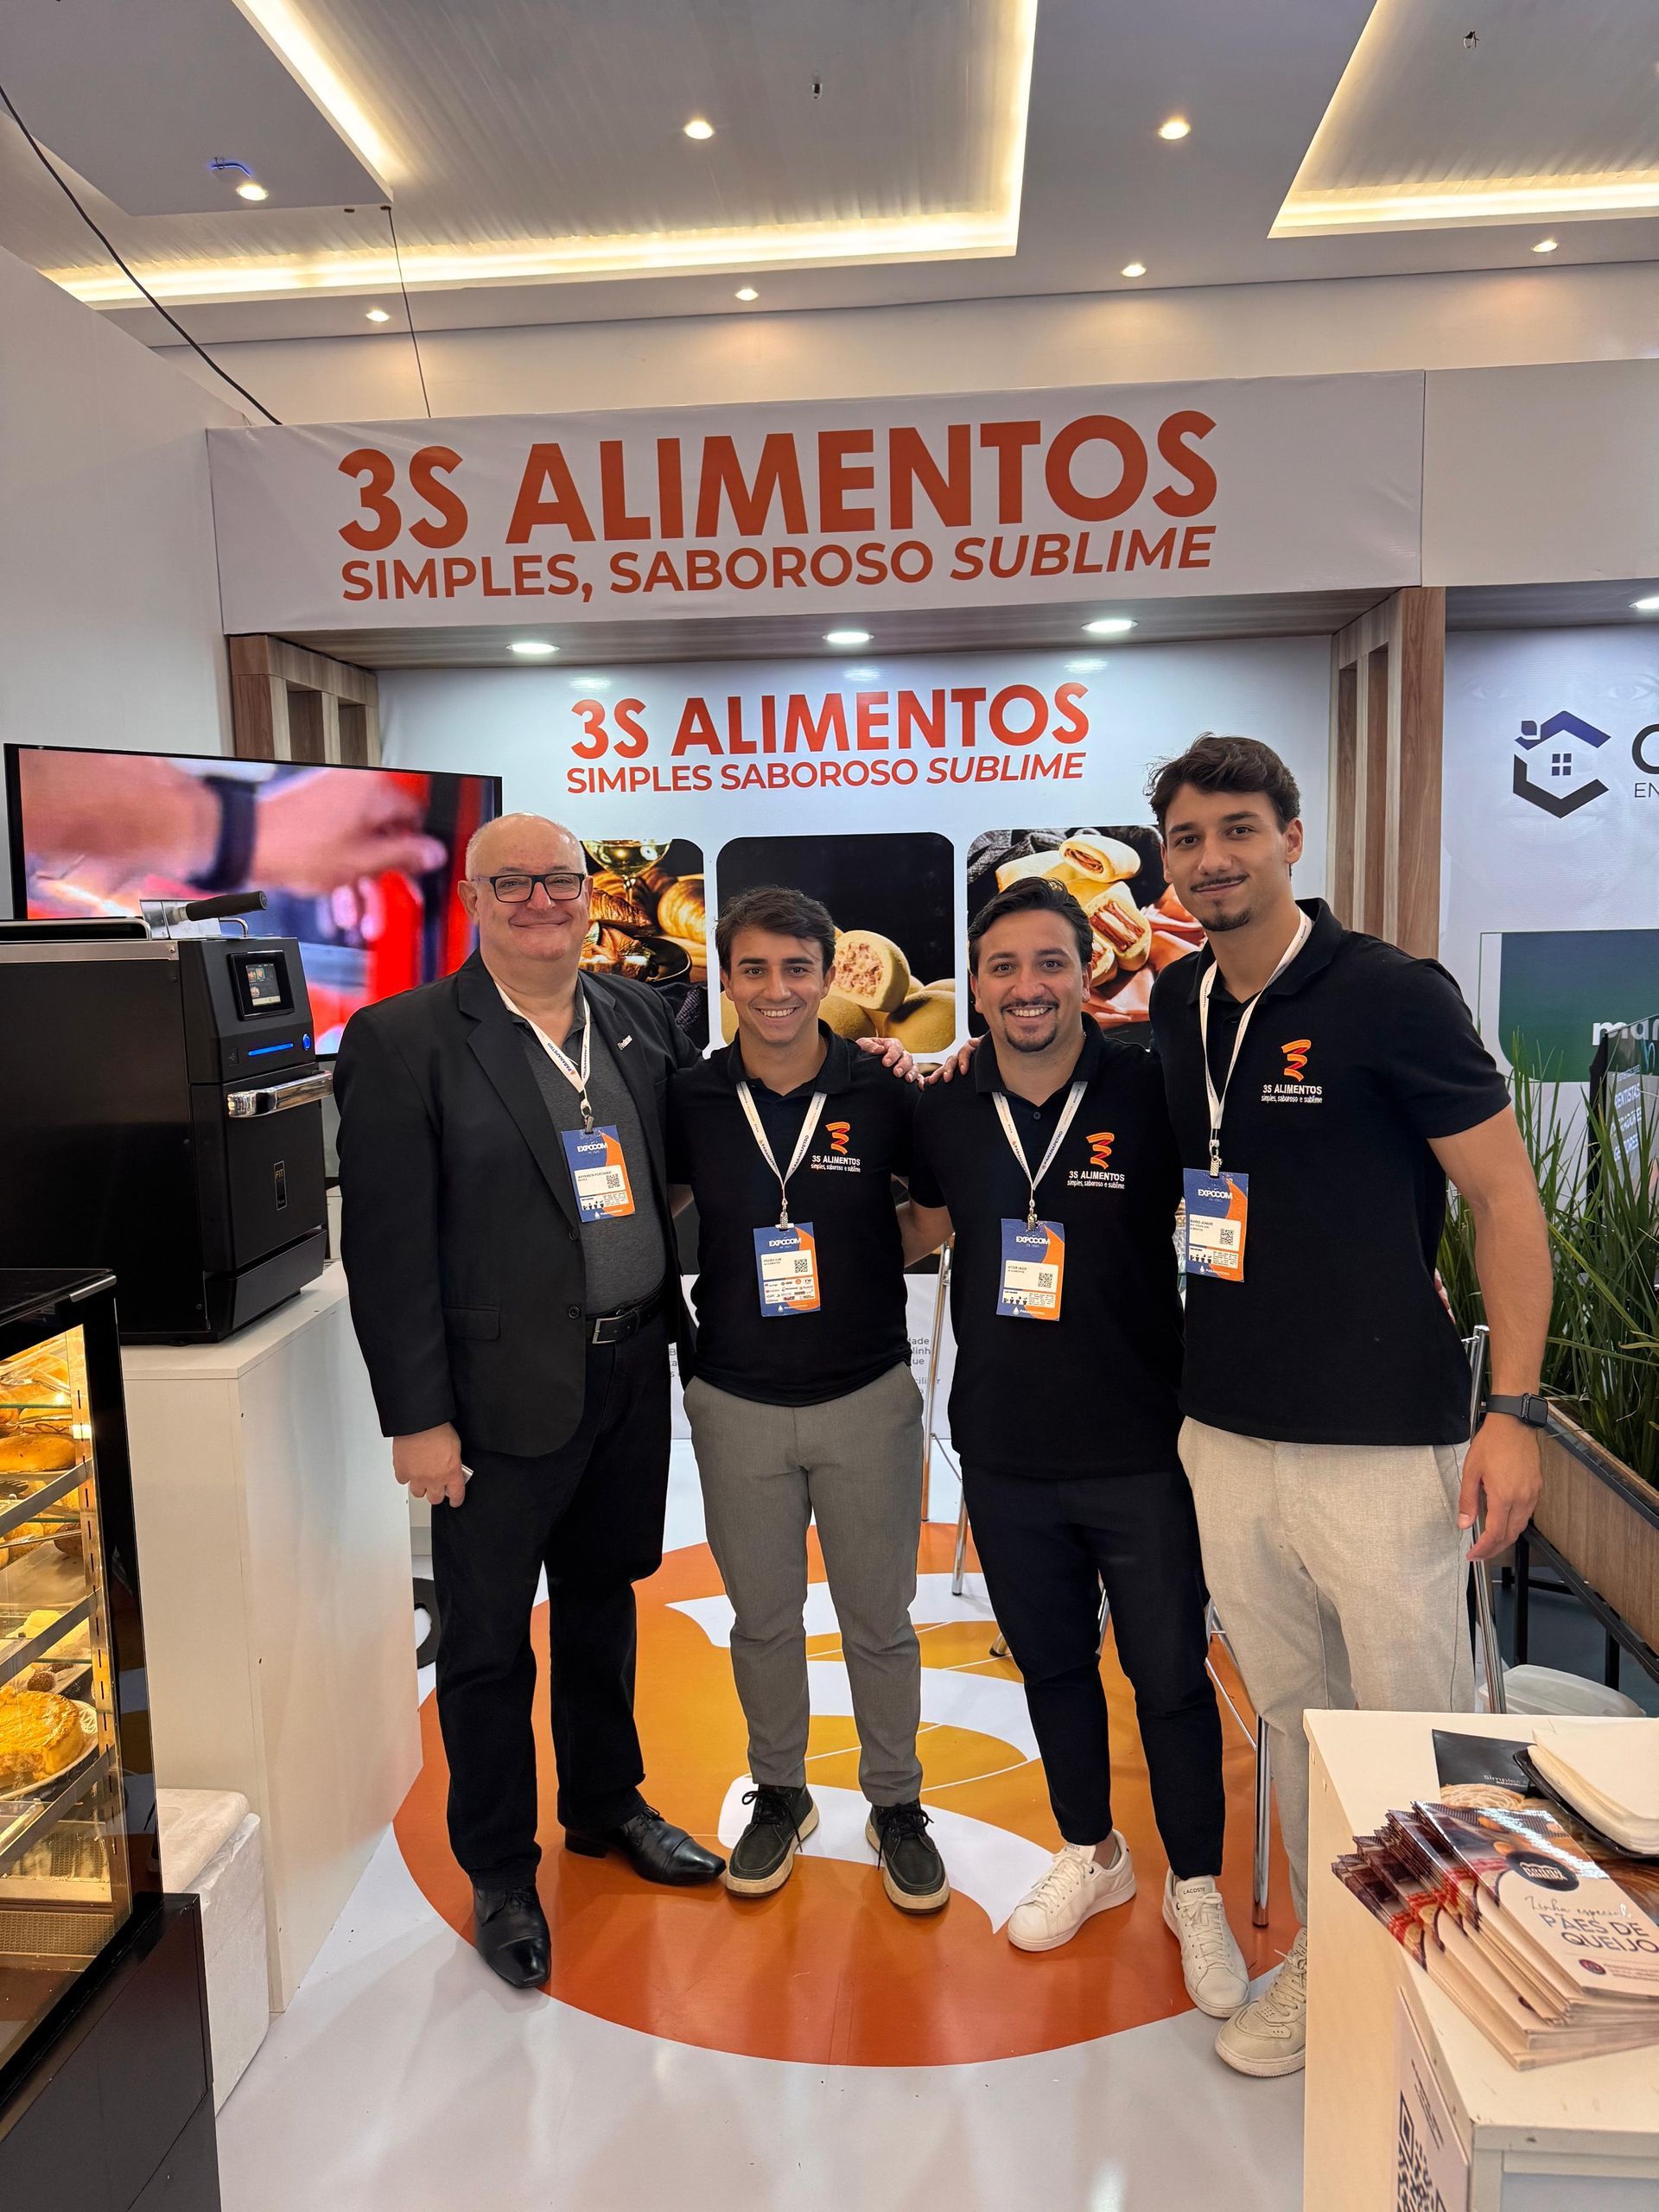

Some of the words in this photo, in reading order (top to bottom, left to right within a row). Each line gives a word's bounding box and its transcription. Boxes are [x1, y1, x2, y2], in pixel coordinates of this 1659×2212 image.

[339, 445, 467, 550] 3S
[505, 410, 1217, 544] ALIMENTOS
[342, 554, 593, 603] SIMPLES,
[609, 539, 933, 594] SABOROSO
[950, 525, 1217, 581] SUBLIME
[571, 698, 649, 760] 3S
[671, 683, 1090, 757] ALIMENTOS
[566, 765, 712, 794] SIMPLES
[721, 759, 918, 790] SABOROSO
[926, 752, 1086, 785] SUBLIME
[1262, 1084, 1273, 1094] 3S
[1274, 1084, 1323, 1096] ALIMENTOS
[811, 1154, 821, 1163] 3S
[823, 1154, 861, 1166] ALIMENTOS
[1069, 1170, 1078, 1179] 3S
[1080, 1170, 1125, 1182] ALIMENTOS
[1198, 1188, 1233, 1200] EXPOCOM
[769, 1237, 802, 1247] EXPOCOM
[1015, 1236, 1051, 1245] EXPOCOM
[1183, 1886, 1206, 1895] LACOSTE
[1539, 1912, 1609, 1935] PÃES
[1609, 1921, 1649, 1937] DE
[1560, 1931, 1659, 1954] QUEIJO
